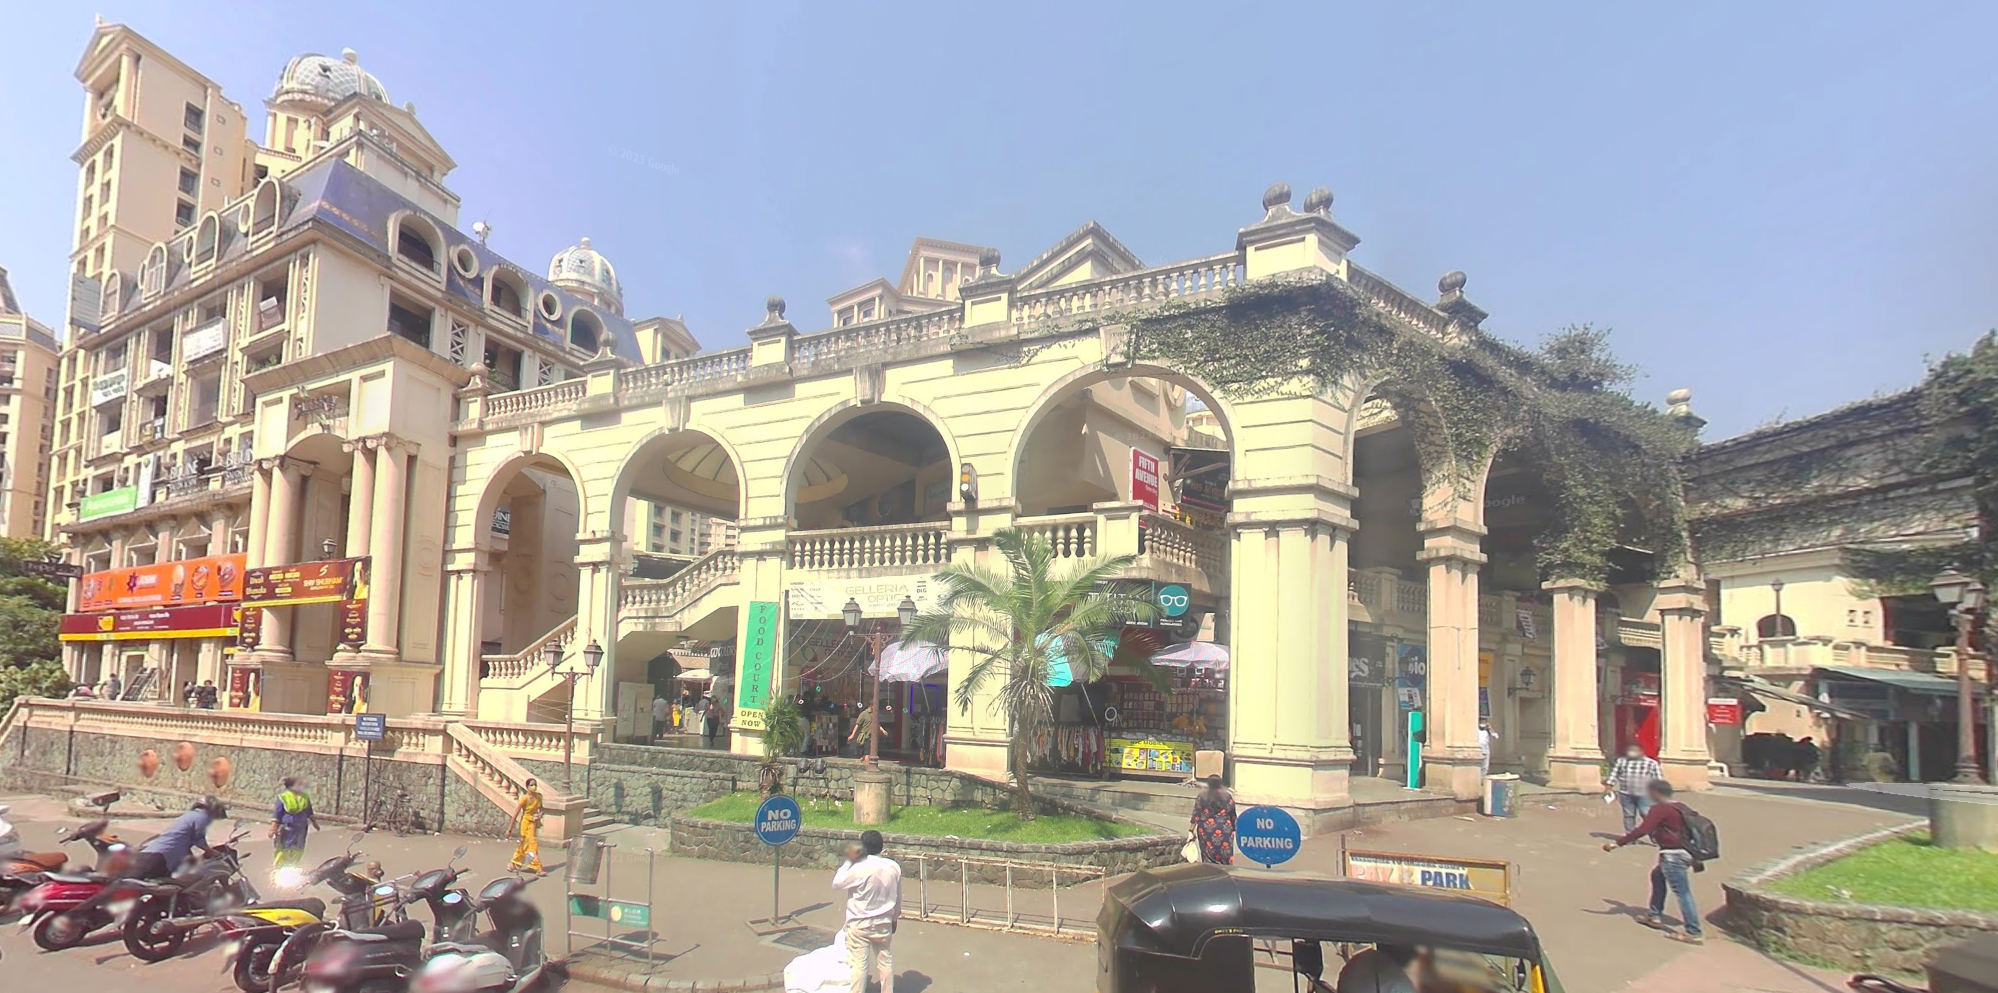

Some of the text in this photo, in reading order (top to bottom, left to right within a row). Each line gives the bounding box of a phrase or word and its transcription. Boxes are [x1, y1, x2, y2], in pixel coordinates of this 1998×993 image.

[1138, 455, 1155, 474] FIFTH
[1134, 468, 1158, 488] AVENUE
[845, 583, 909, 595] GELLERIA
[750, 605, 766, 704] FOOD COURT
[740, 709, 764, 719] OPEN
[741, 719, 761, 728] NOW
[767, 808, 792, 821] NO
[760, 819, 797, 833] PARKING
[1256, 817, 1275, 830] NO
[1240, 835, 1294, 849] PARKING
[1351, 864, 1394, 884] PAY
[1420, 869, 1473, 890] PARK
